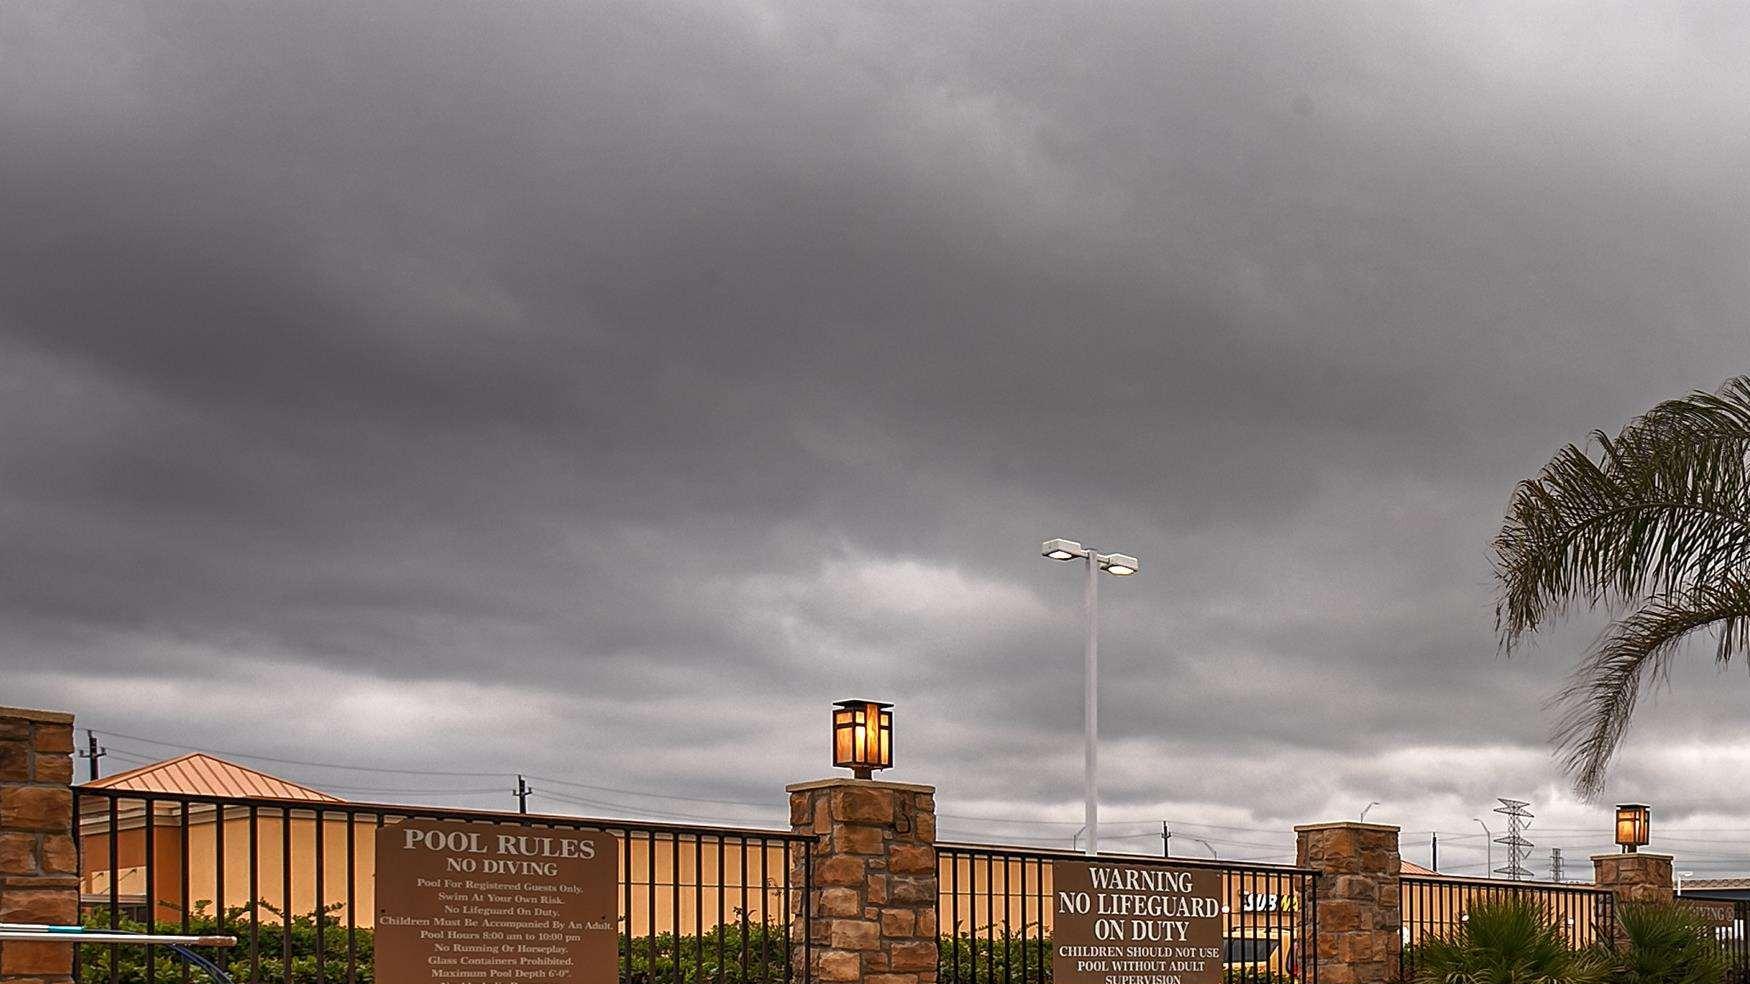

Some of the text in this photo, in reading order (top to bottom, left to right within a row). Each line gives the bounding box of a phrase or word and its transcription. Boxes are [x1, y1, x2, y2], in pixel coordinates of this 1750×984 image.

[403, 828, 596, 860] POOL RULES
[446, 857, 559, 877] NO DIVING
[417, 878, 584, 895] Pool For Registered Guests Only.
[1089, 867, 1193, 893] WARNING
[438, 891, 469, 902] Swim
[471, 893, 484, 902] At
[487, 893, 513, 903] Your
[515, 894, 538, 904] Own
[1058, 891, 1219, 918] NO LIFEGUARD
[444, 905, 560, 918] No Lifeguard On Duty.
[379, 916, 613, 930] Children Must Be Accompanied By An Adult.
[420, 930, 444, 939] Pool
[447, 930, 480, 939] Hours
[482, 931, 504, 940] 8:00
[539, 932, 563, 941] 10:00
[1094, 918, 1190, 942] ON DUTY
[434, 943, 568, 954] No Running Or Horseplay.
[1059, 946, 1220, 959] CHILDREN SHOULD NOT USE
[427, 956, 574, 966] Glass Containers Prohibited.
[1077, 961, 1206, 973] POOL WITHOUT ADULT
[431, 968, 487, 978] Maximum
[490, 969, 512, 978] Pool
[515, 970, 546, 980] Depth
